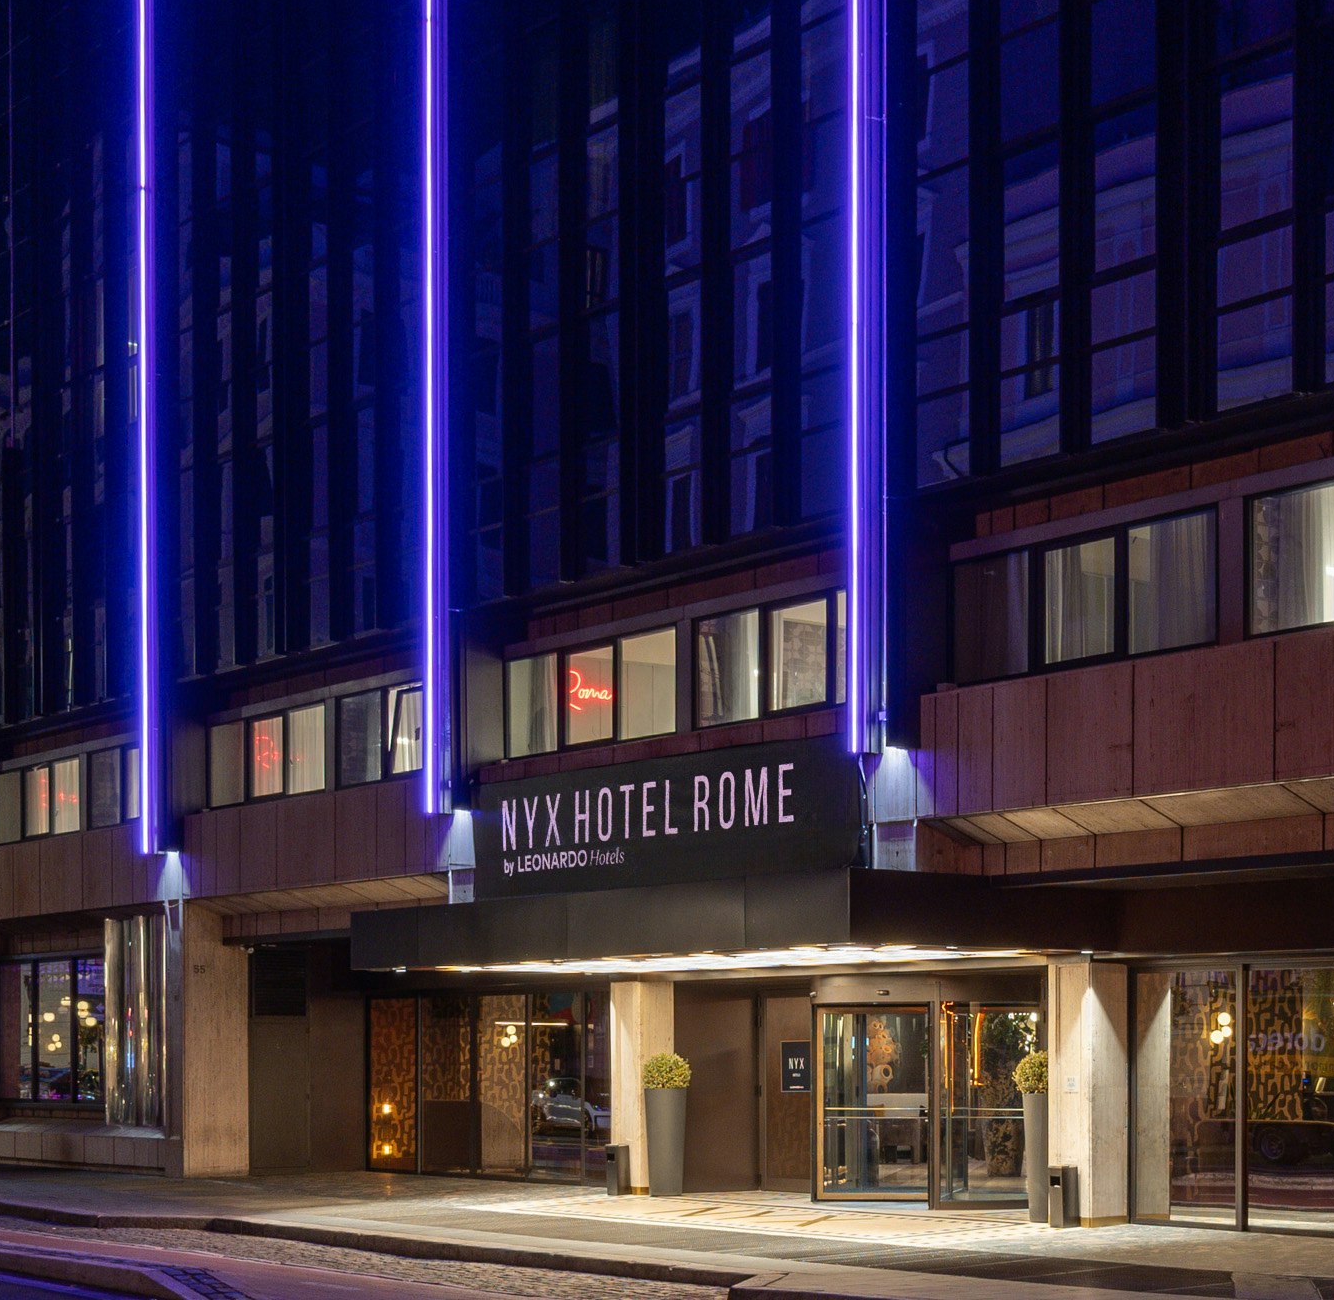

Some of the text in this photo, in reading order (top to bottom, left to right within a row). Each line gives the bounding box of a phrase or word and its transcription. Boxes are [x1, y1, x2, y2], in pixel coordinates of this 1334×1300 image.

[502, 762, 794, 851] NYX HOTEL ROME
[503, 847, 625, 877] by LEONARDO Hotels
[788, 1057, 805, 1070] NYX
